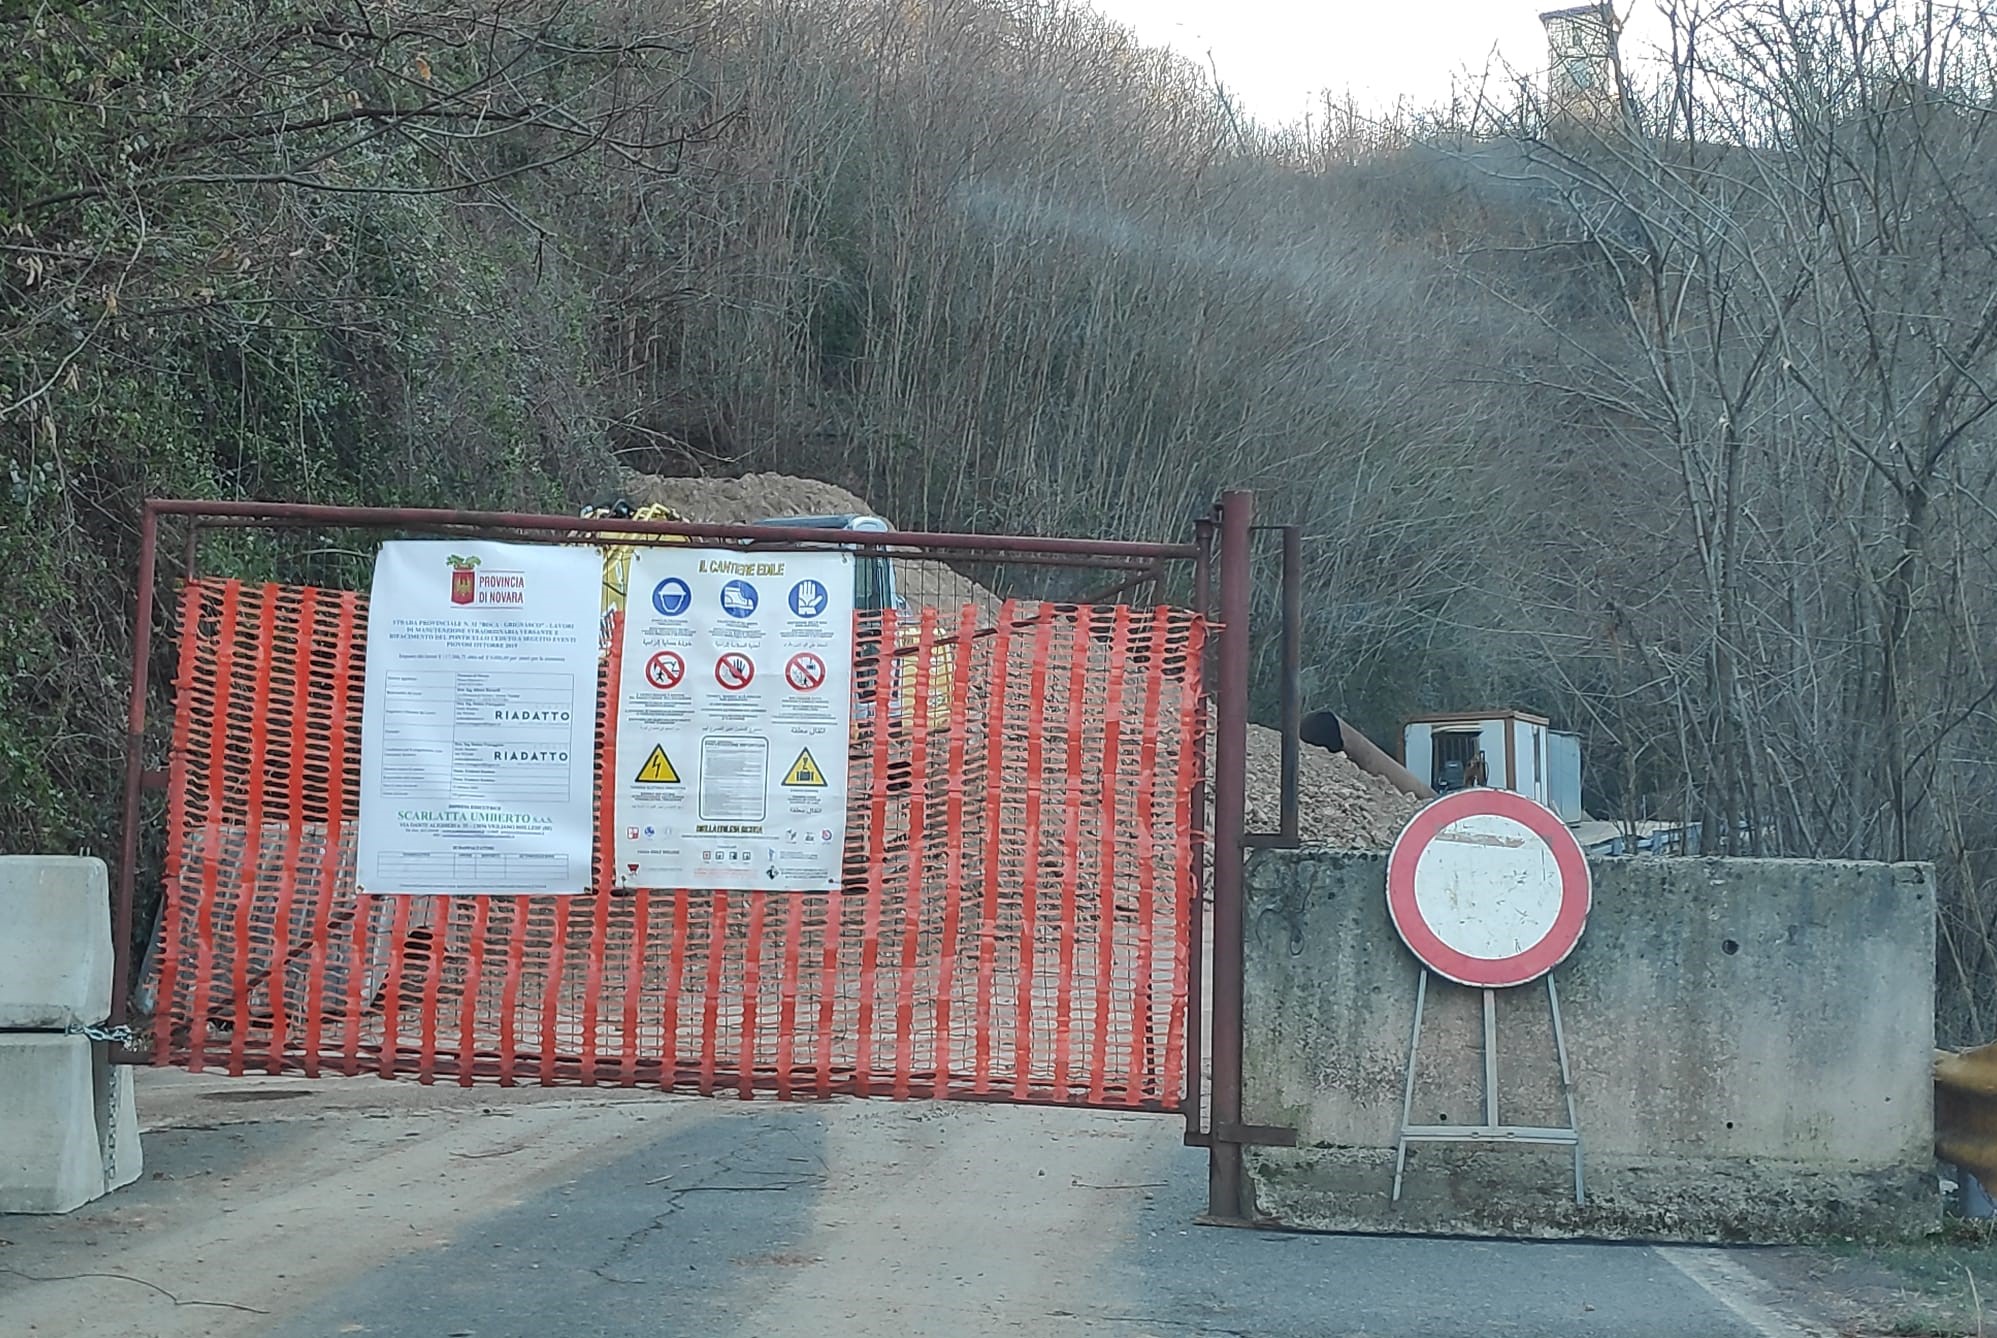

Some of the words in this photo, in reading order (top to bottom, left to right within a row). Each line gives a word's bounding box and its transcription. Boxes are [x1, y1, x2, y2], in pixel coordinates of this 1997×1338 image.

[709, 560, 755, 576] CANTIERE
[756, 563, 785, 577] EDILE
[479, 576, 525, 588] PROVINCIA
[479, 591, 488, 603] DI
[489, 592, 524, 604] NOVARA
[495, 710, 570, 721] RIADATTO
[494, 751, 569, 761] RIADATTO
[398, 811, 467, 821] SCARLATTA
[471, 812, 531, 823] UMBERTO
